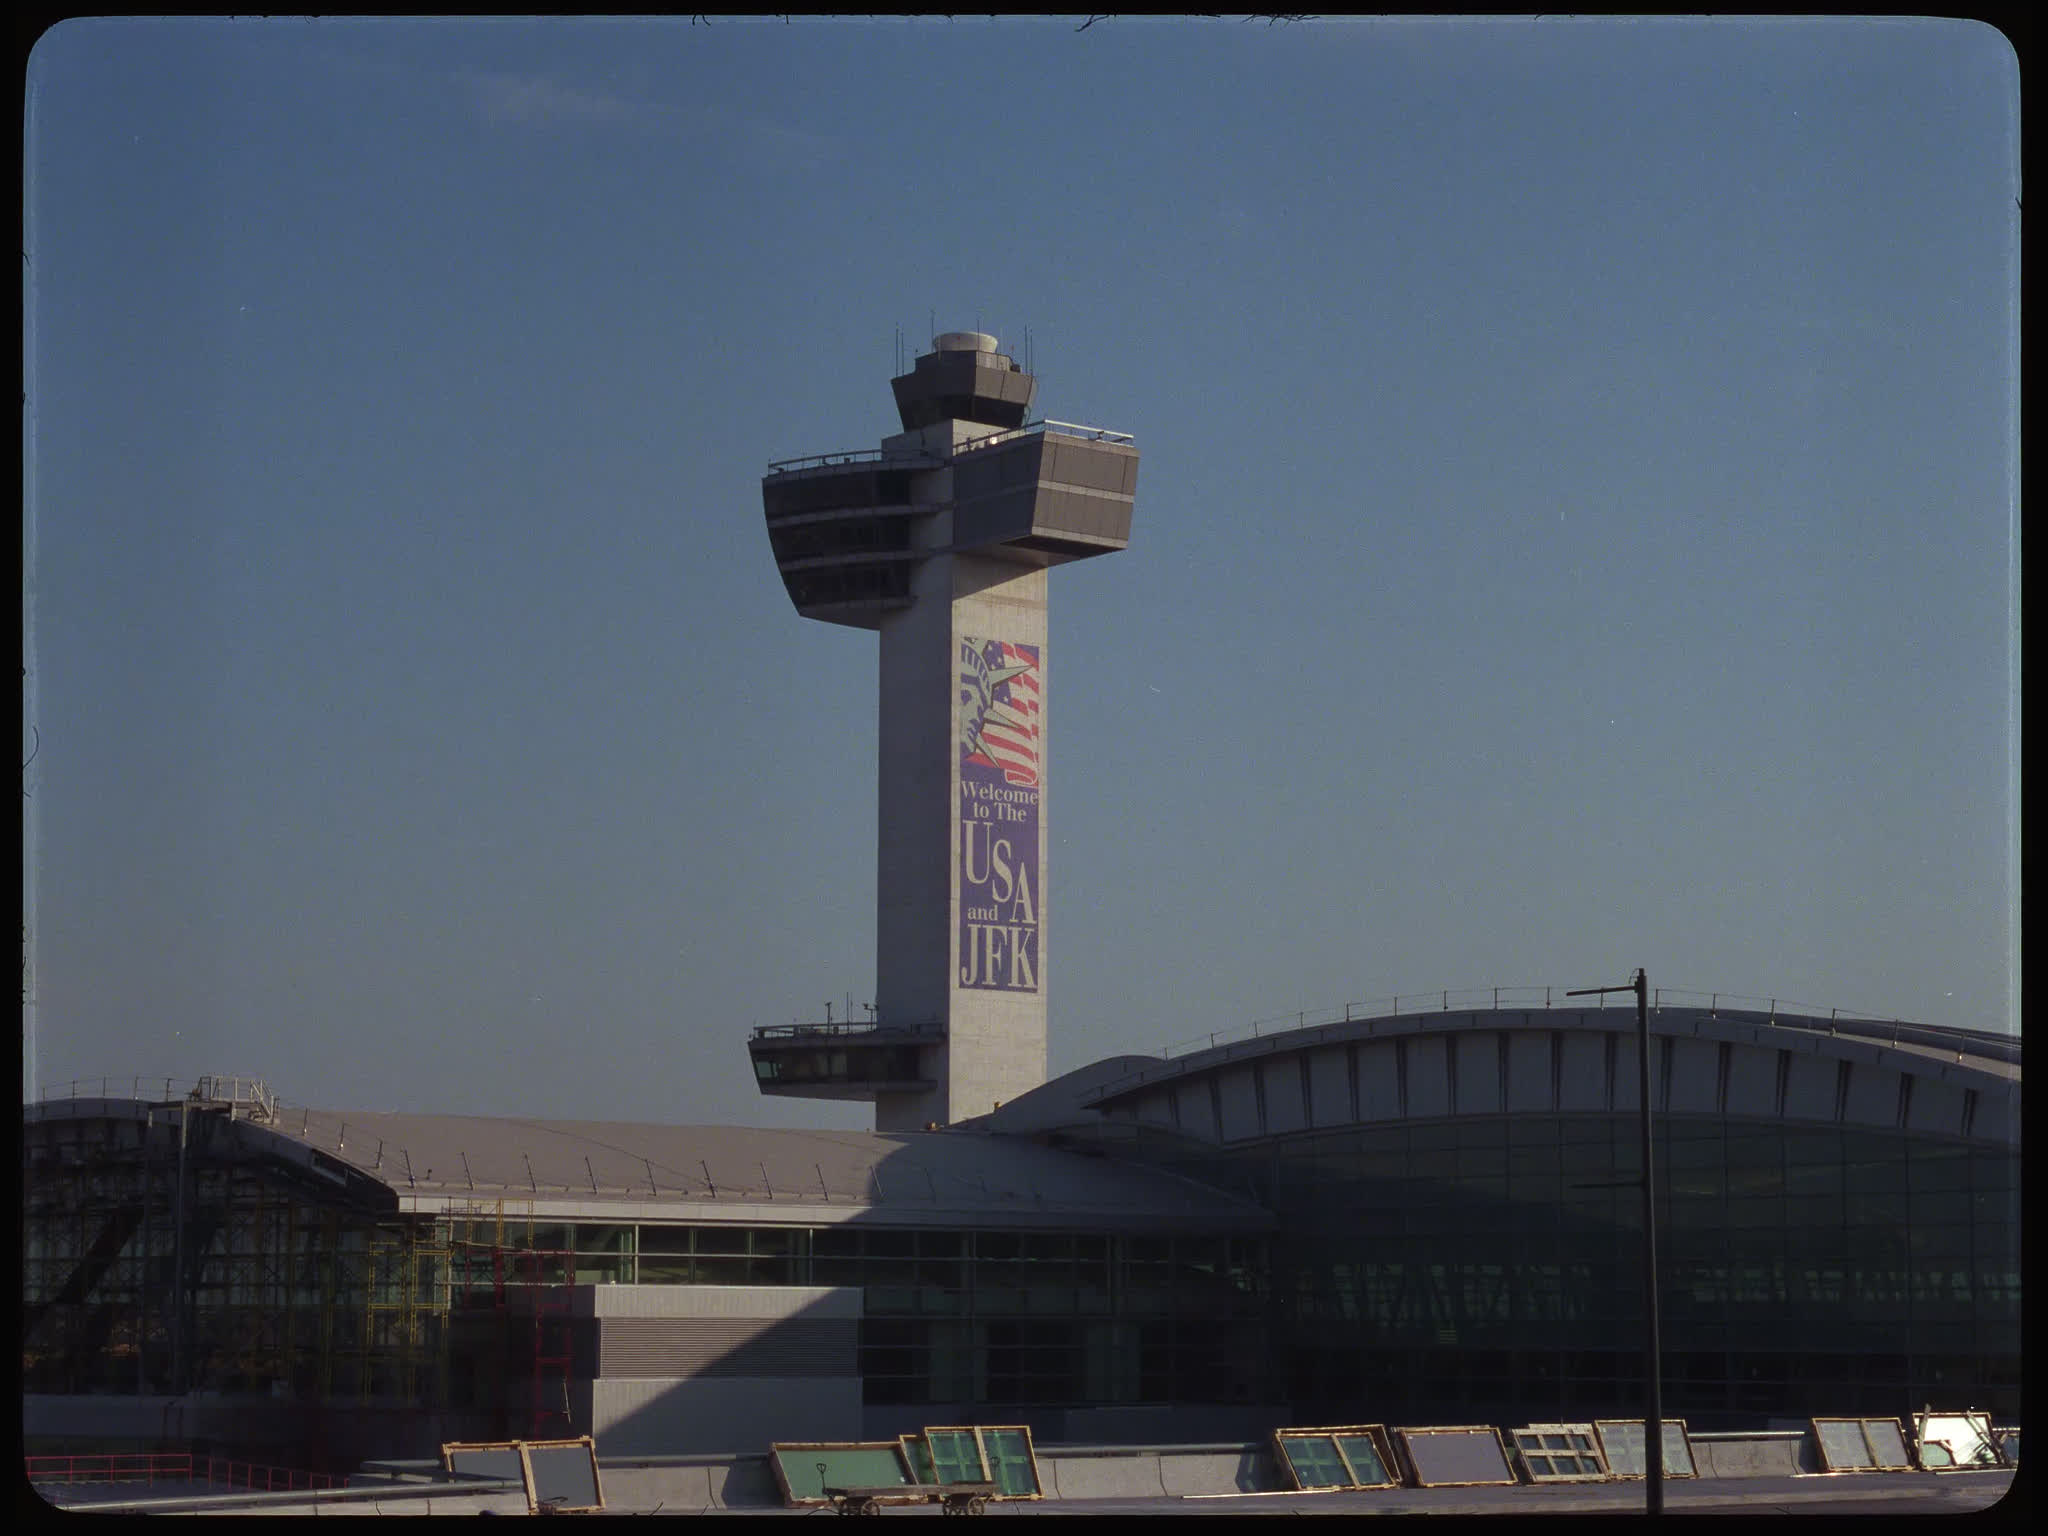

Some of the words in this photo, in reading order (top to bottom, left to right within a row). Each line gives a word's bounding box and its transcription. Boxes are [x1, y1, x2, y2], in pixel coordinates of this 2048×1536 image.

[961, 780, 1038, 805] Welcome
[973, 801, 989, 819] to
[994, 802, 1027, 822] The
[962, 820, 1037, 924] USA
[967, 904, 999, 921] and
[961, 924, 1038, 989] JFK
